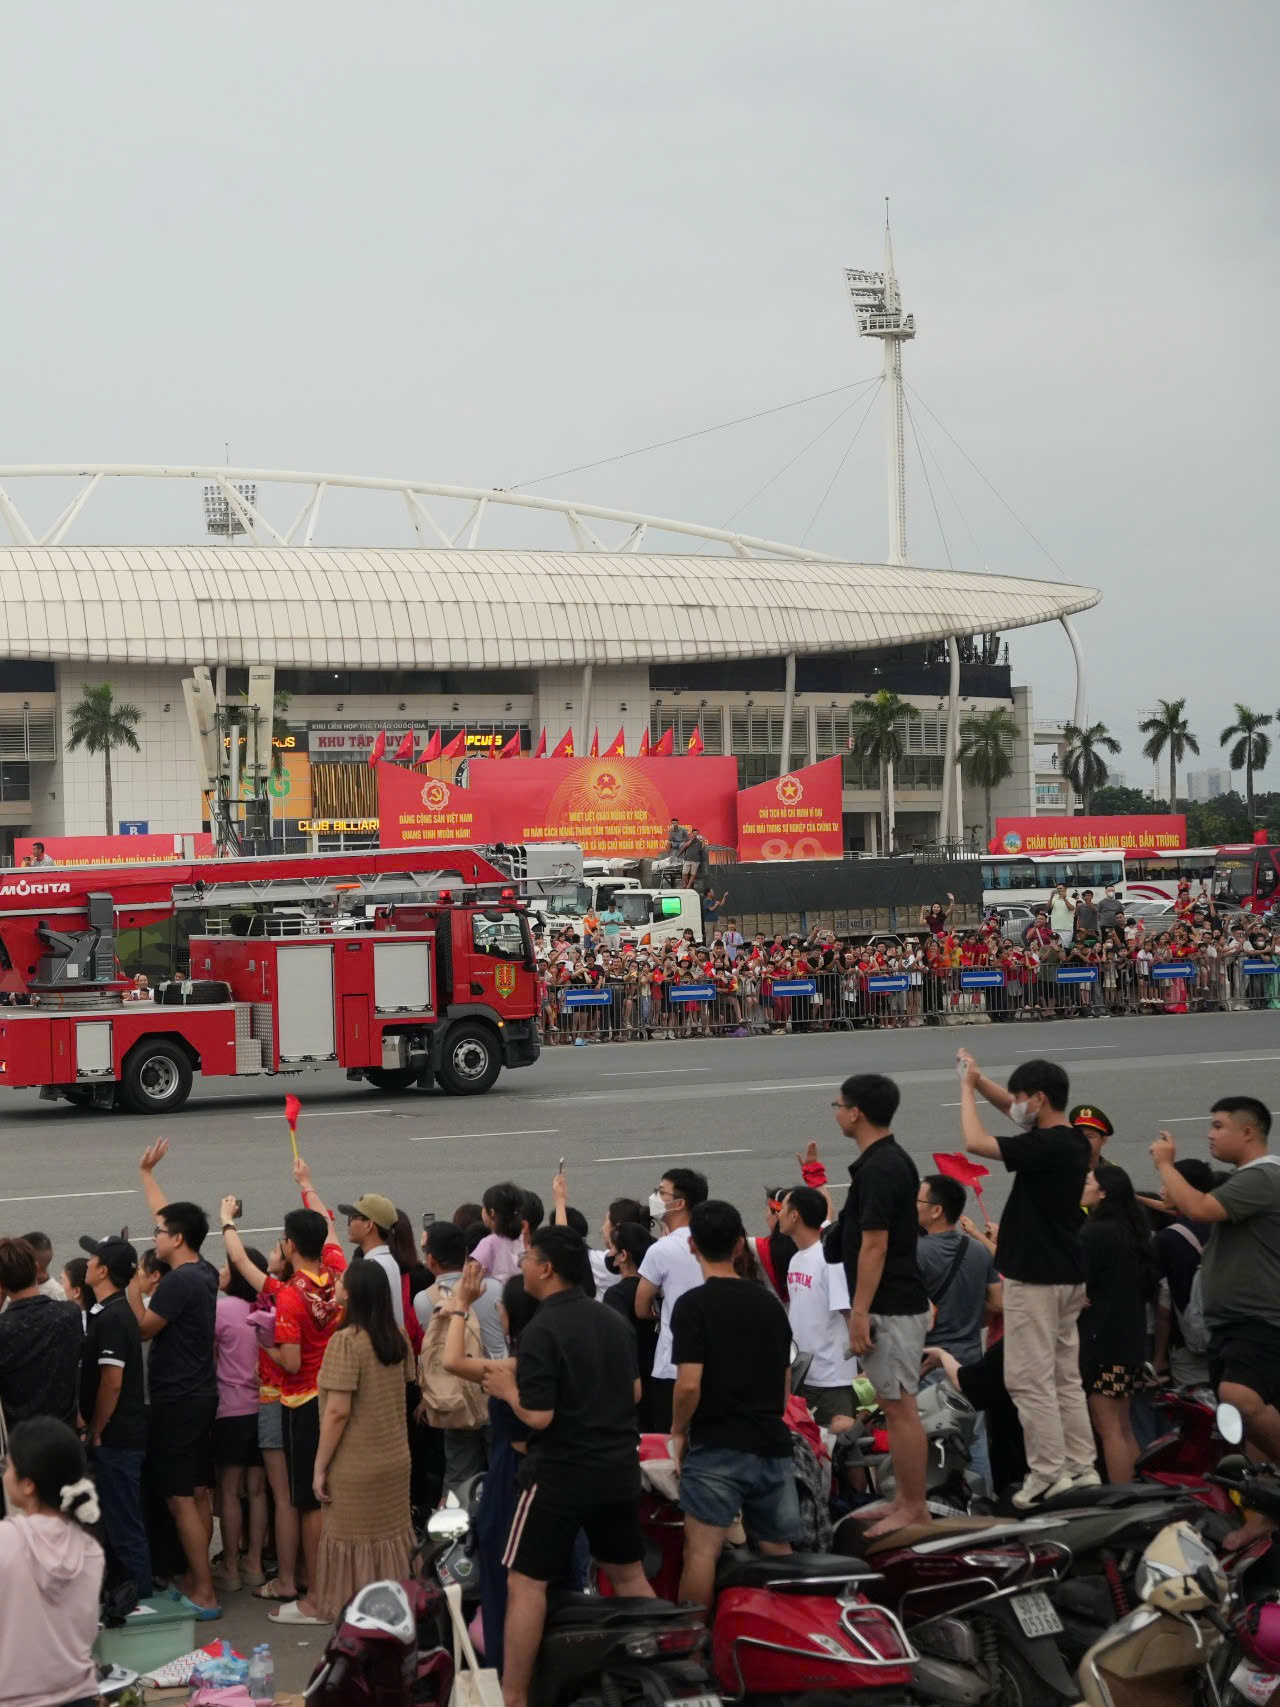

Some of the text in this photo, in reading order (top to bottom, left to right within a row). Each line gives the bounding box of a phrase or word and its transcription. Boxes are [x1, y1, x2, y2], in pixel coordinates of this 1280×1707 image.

[318, 736, 345, 748] KHU
[298, 820, 380, 831] CLUB BILLIAR
[0, 880, 71, 896] MORITA
